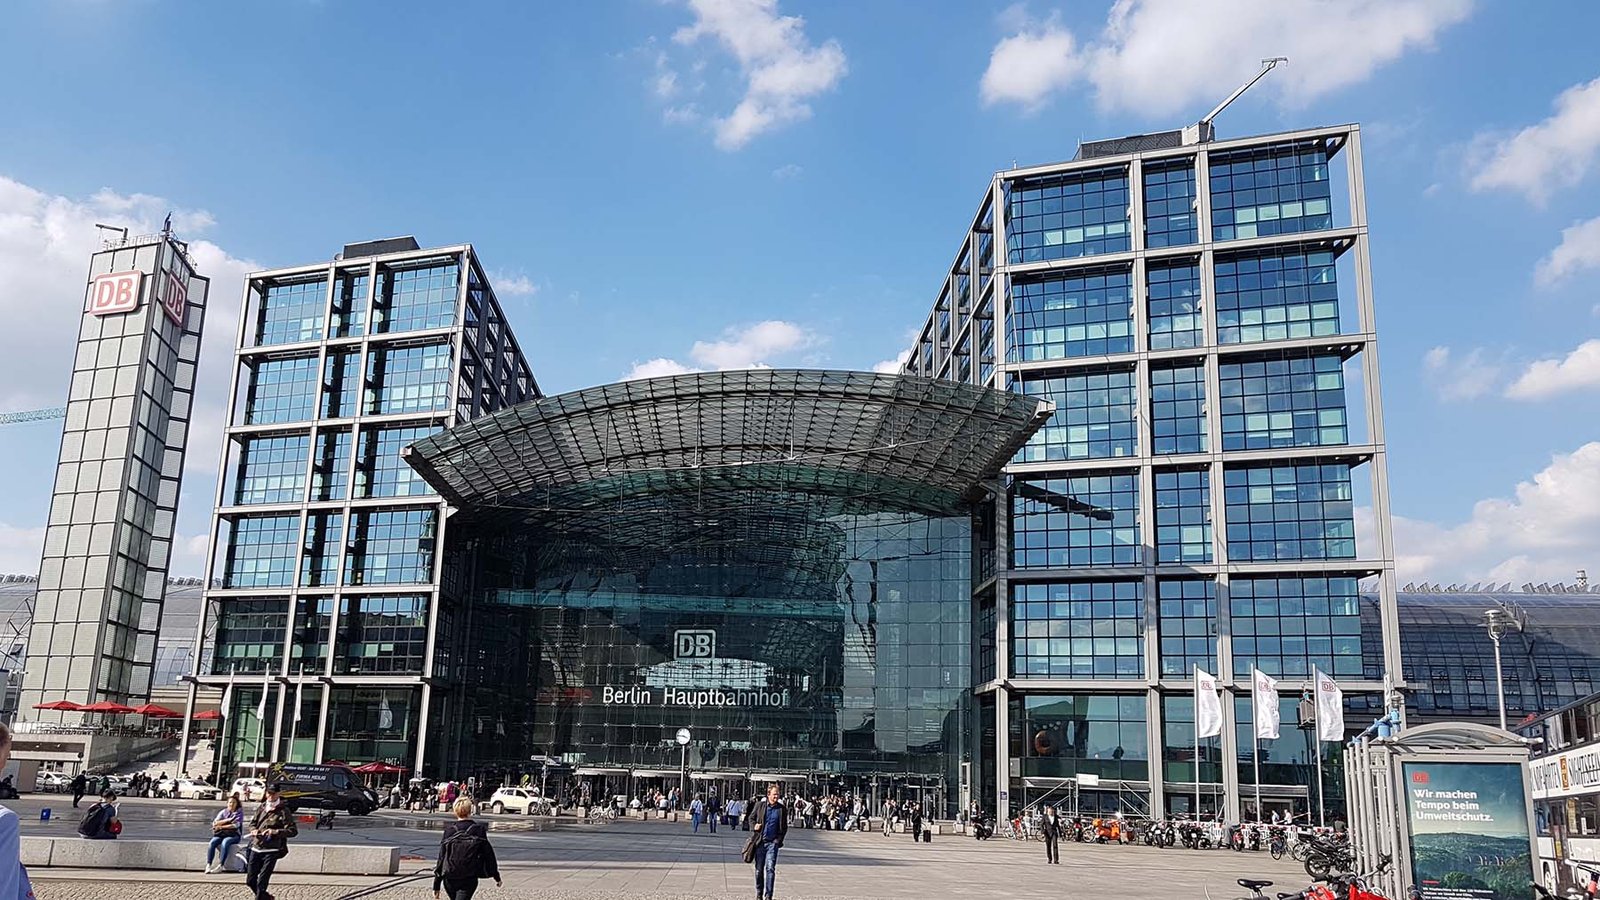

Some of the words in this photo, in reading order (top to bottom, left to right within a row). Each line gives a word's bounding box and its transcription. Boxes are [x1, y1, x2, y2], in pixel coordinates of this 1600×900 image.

[96, 277, 133, 308] DB
[167, 278, 184, 317] DB
[678, 634, 711, 657] DB
[602, 686, 651, 704] Berlin
[663, 688, 790, 709] Hauptbahnhof
[1414, 789, 1434, 798] Wir
[1435, 790, 1477, 799] machen
[1415, 800, 1450, 810] Tempo
[1452, 801, 1479, 810] beim
[1416, 811, 1494, 822] Umweltschutz.
